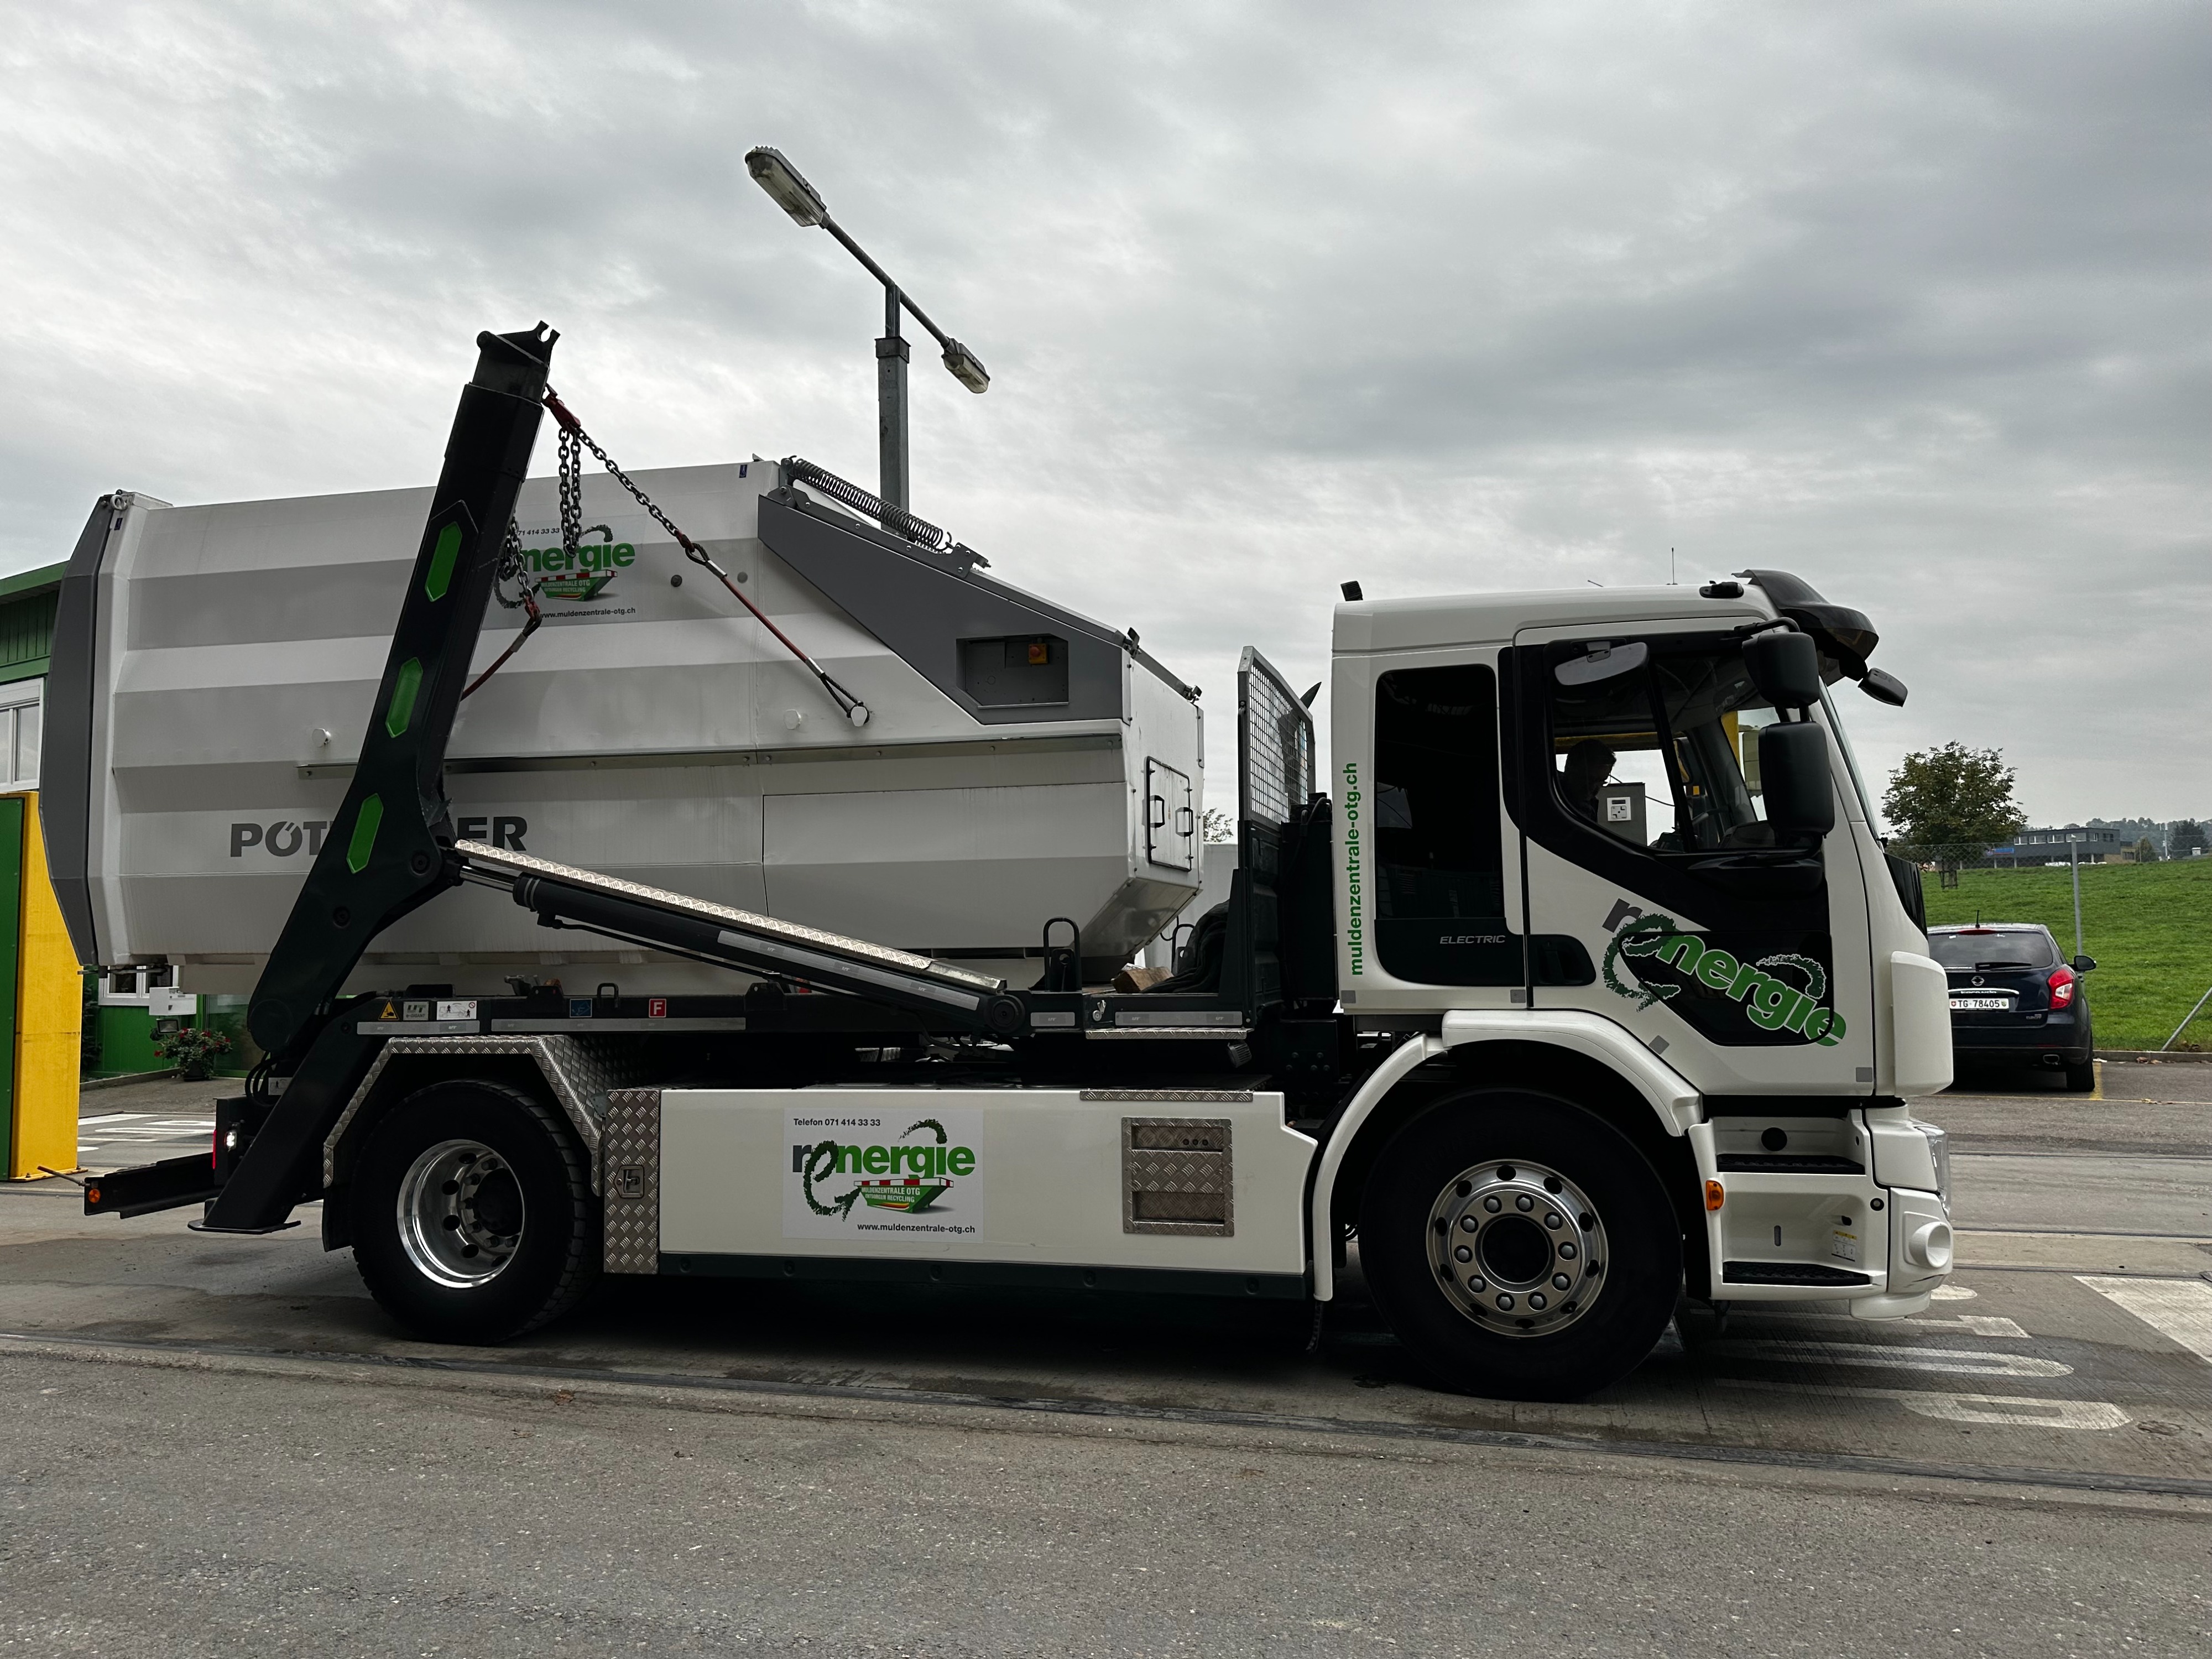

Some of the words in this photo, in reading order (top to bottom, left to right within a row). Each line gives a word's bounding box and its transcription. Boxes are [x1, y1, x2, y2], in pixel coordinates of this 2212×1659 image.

[1342, 763, 1363, 975] muldenzentrale-otg.ch
[1439, 935, 1506, 945] ELECTRIC
[653, 1001, 662, 1015] F
[793, 1118, 823, 1126] Telefon
[825, 1118, 839, 1126] 071
[906, 1187, 921, 1196] OTG
[886, 1194, 915, 1203] RECYCLING
[857, 1223, 975, 1234] www.muldenzentrale-otg.ch
